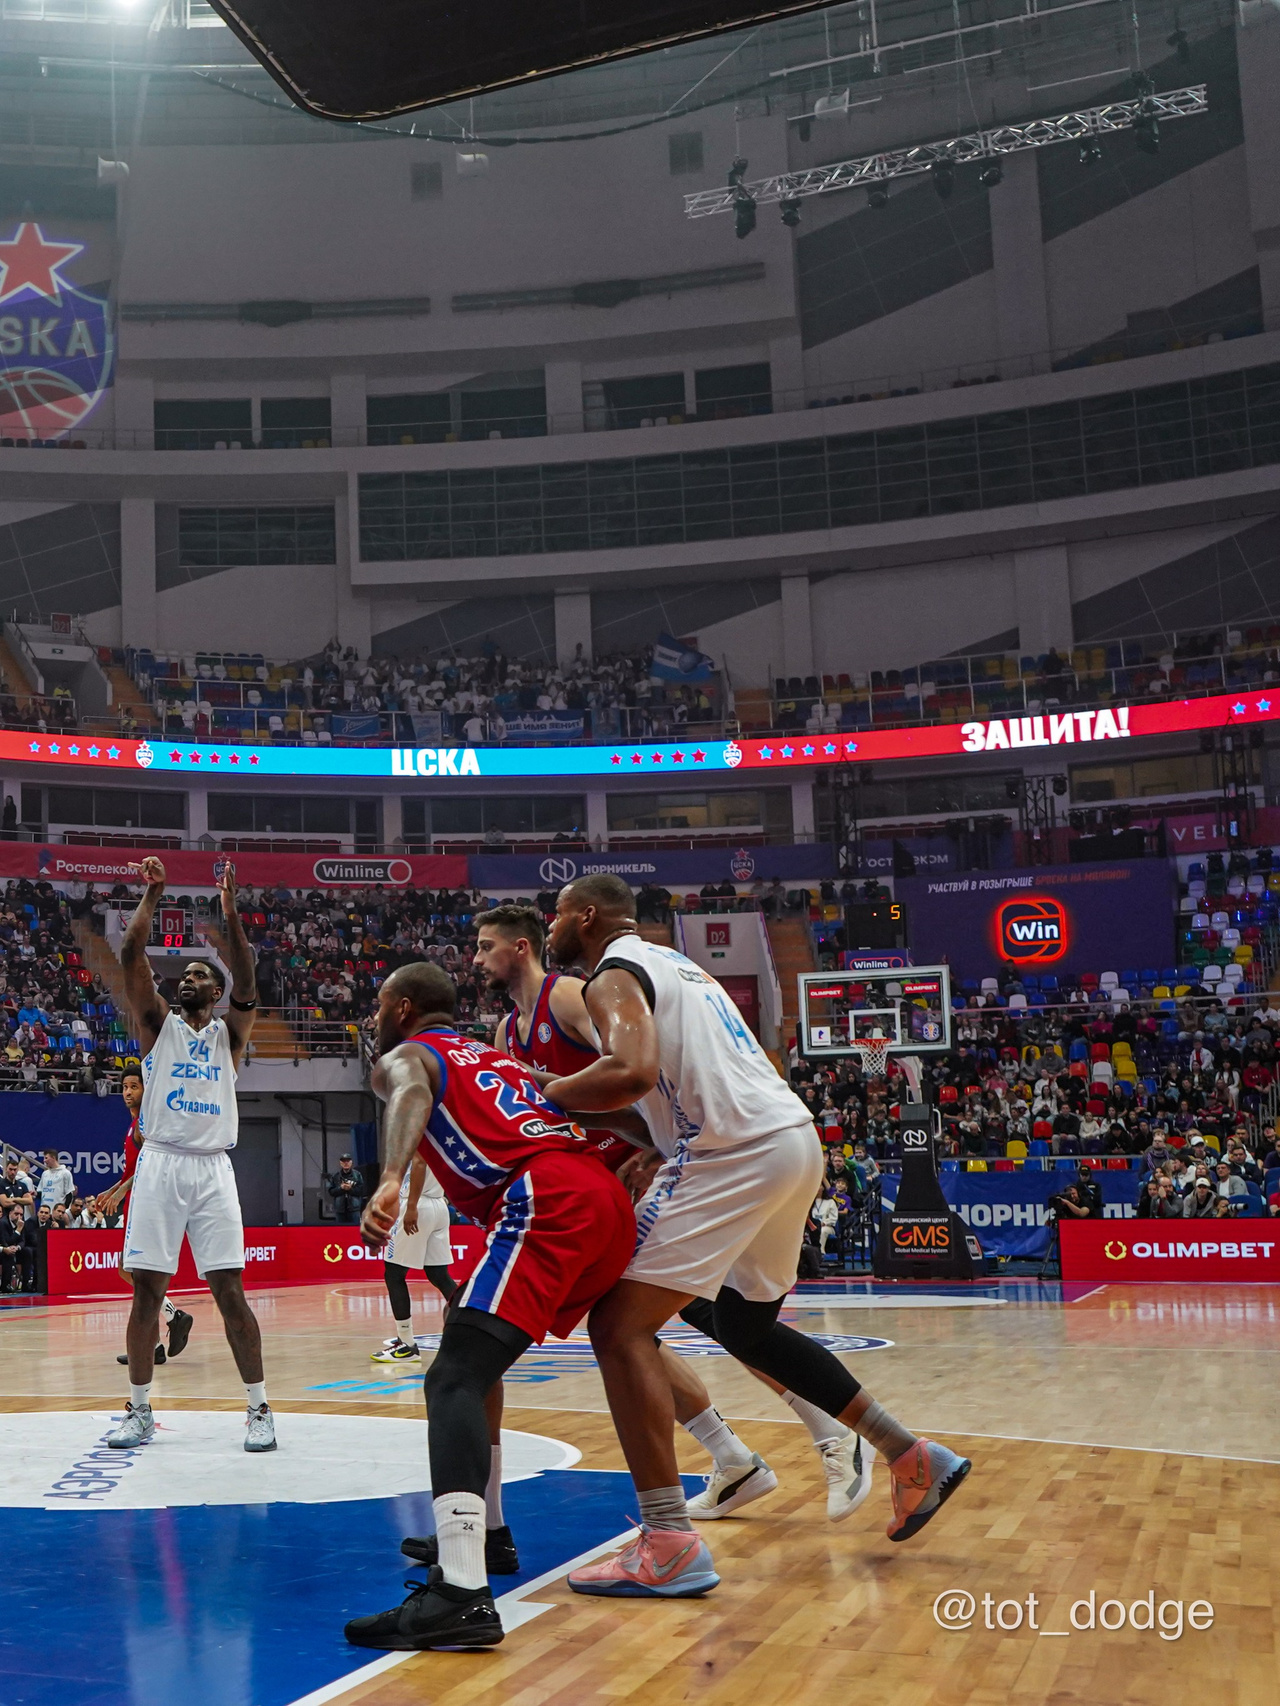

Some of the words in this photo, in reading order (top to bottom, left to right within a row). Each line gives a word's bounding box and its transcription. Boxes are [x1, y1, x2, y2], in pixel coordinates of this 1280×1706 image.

[961, 707, 1132, 752] ЗАЩИТА!
[391, 748, 481, 776] ЦСКА
[56, 859, 138, 876] Ростелеком
[323, 864, 385, 879] Winline
[582, 864, 656, 875] НОРНИКЕЛЬ
[928, 879, 969, 893] УЧАСТВУЙ
[971, 881, 977, 890] В
[979, 876, 1033, 889] РОЗЫГРЫШЕ
[890, 904, 901, 920] 5
[165, 918, 180, 932] D1
[1013, 921, 1059, 940] Win
[163, 934, 183, 947] 80
[710, 930, 726, 944] D2
[854, 959, 889, 969] Winline
[188, 1040, 209, 1062] 24
[184, 1101, 221, 1116] ГАЗПРОМ
[892, 1225, 950, 1246] GMS
[1132, 1242, 1276, 1259] OLIMPBET
[462, 1522, 474, 1531] 24
